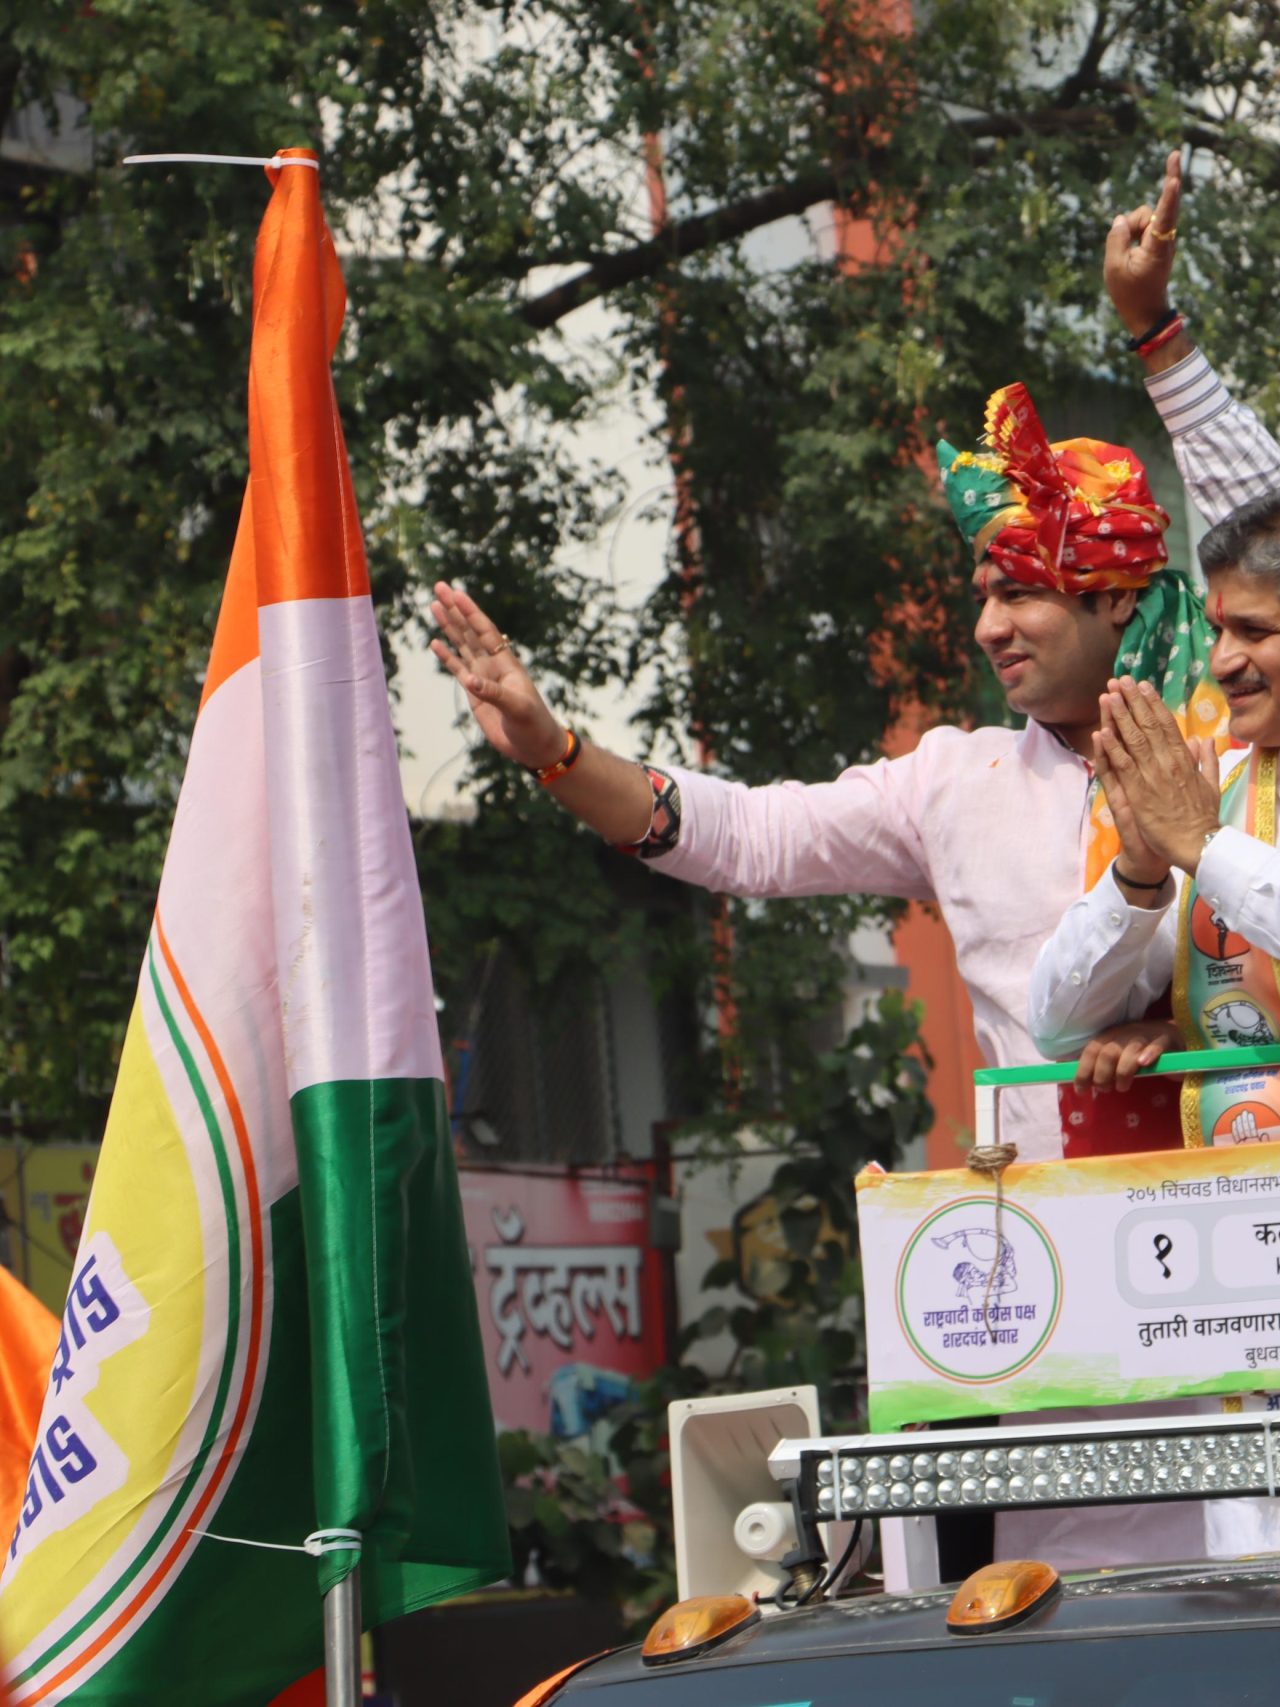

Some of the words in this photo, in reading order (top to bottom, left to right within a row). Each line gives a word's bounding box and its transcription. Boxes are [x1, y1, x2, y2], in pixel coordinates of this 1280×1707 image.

[1126, 1187, 1156, 1203] २०५
[1161, 1180, 1212, 1200] चिंचवड
[1152, 1233, 1173, 1280] १
[923, 1305, 968, 1328] राष्ट्रवादी
[1015, 1304, 1036, 1320] पक्ष
[943, 1326, 987, 1349] शरदचंद्र
[1138, 1314, 1187, 1348] तुतारी
